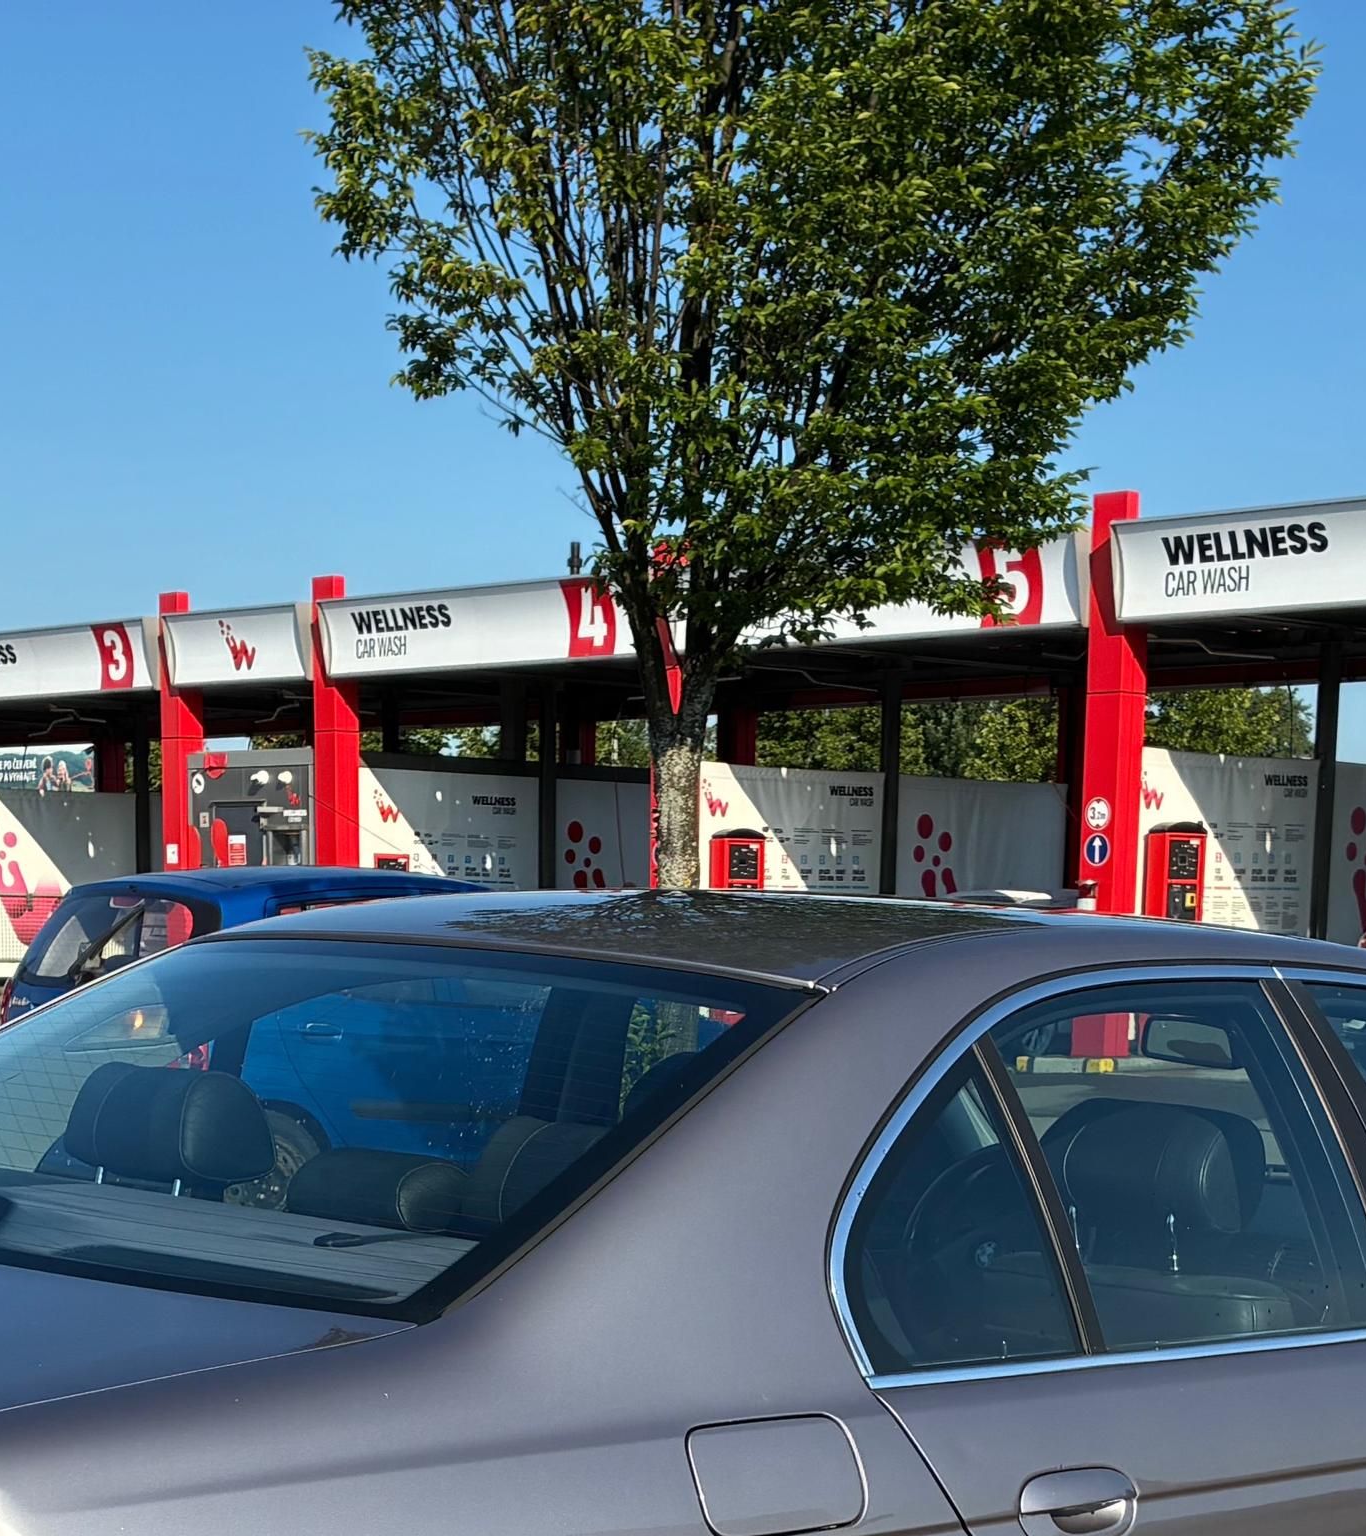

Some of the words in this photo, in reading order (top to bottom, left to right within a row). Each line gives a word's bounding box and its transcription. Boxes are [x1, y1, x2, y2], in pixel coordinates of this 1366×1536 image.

[1161, 522, 1329, 566] WELLNESS
[993, 547, 1031, 617] 5
[1165, 570, 1197, 598] CAR
[1201, 565, 1250, 595] WASH
[350, 604, 452, 635] WELLNESS
[577, 587, 608, 647] 4
[103, 630, 127, 680] 3
[356, 637, 376, 659] CAR
[378, 634, 407, 658] WASH
[829, 786, 874, 797] WELLNESS
[1264, 774, 1309, 787] WELLNESS
[472, 795, 517, 806] WELLNESS
